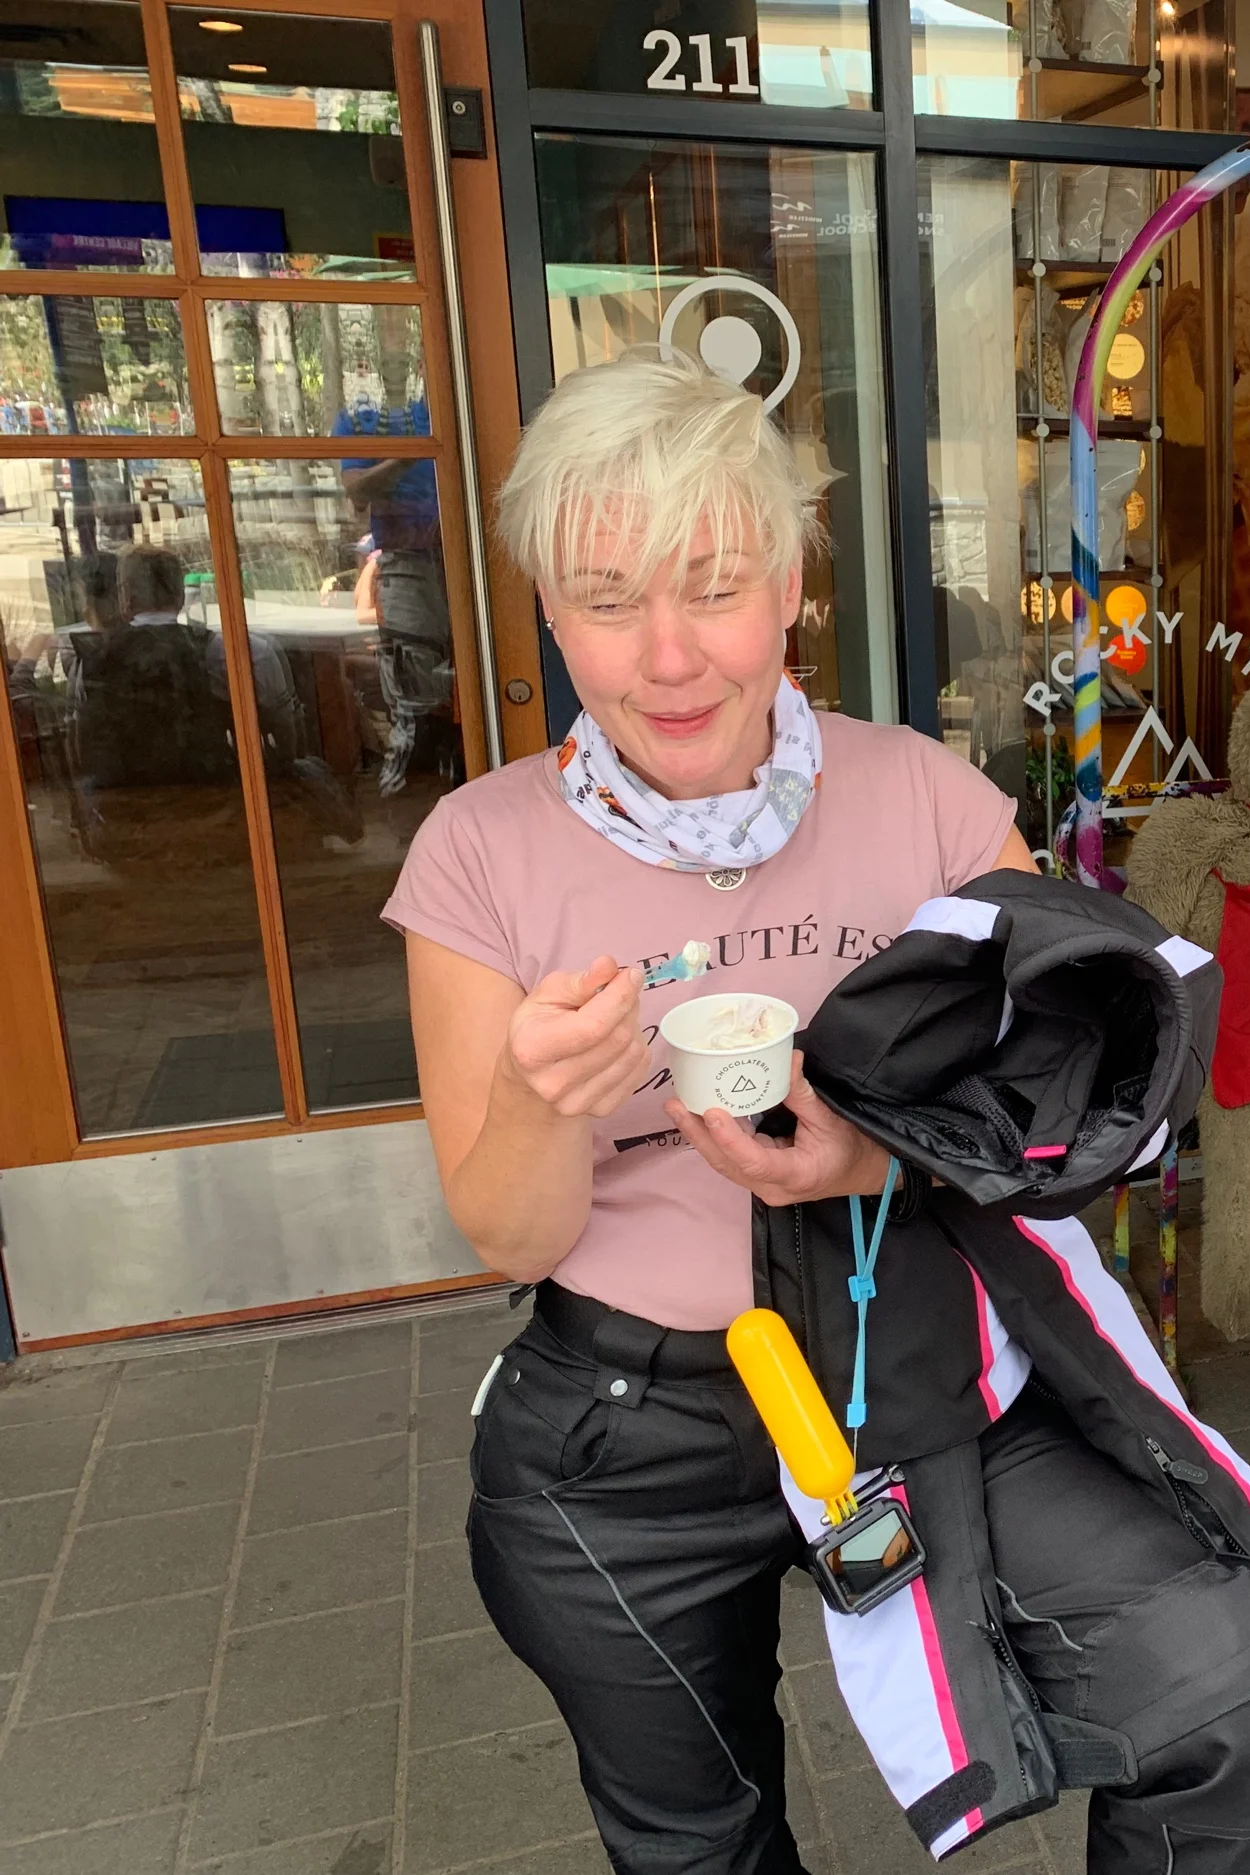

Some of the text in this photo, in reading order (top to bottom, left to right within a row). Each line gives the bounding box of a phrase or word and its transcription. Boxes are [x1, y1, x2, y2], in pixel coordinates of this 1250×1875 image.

[643, 29, 759, 94] 211
[715, 1059, 770, 1081] CHOCOLATERIE
[715, 1080, 771, 1110] ROCKY MOUNTAIN
